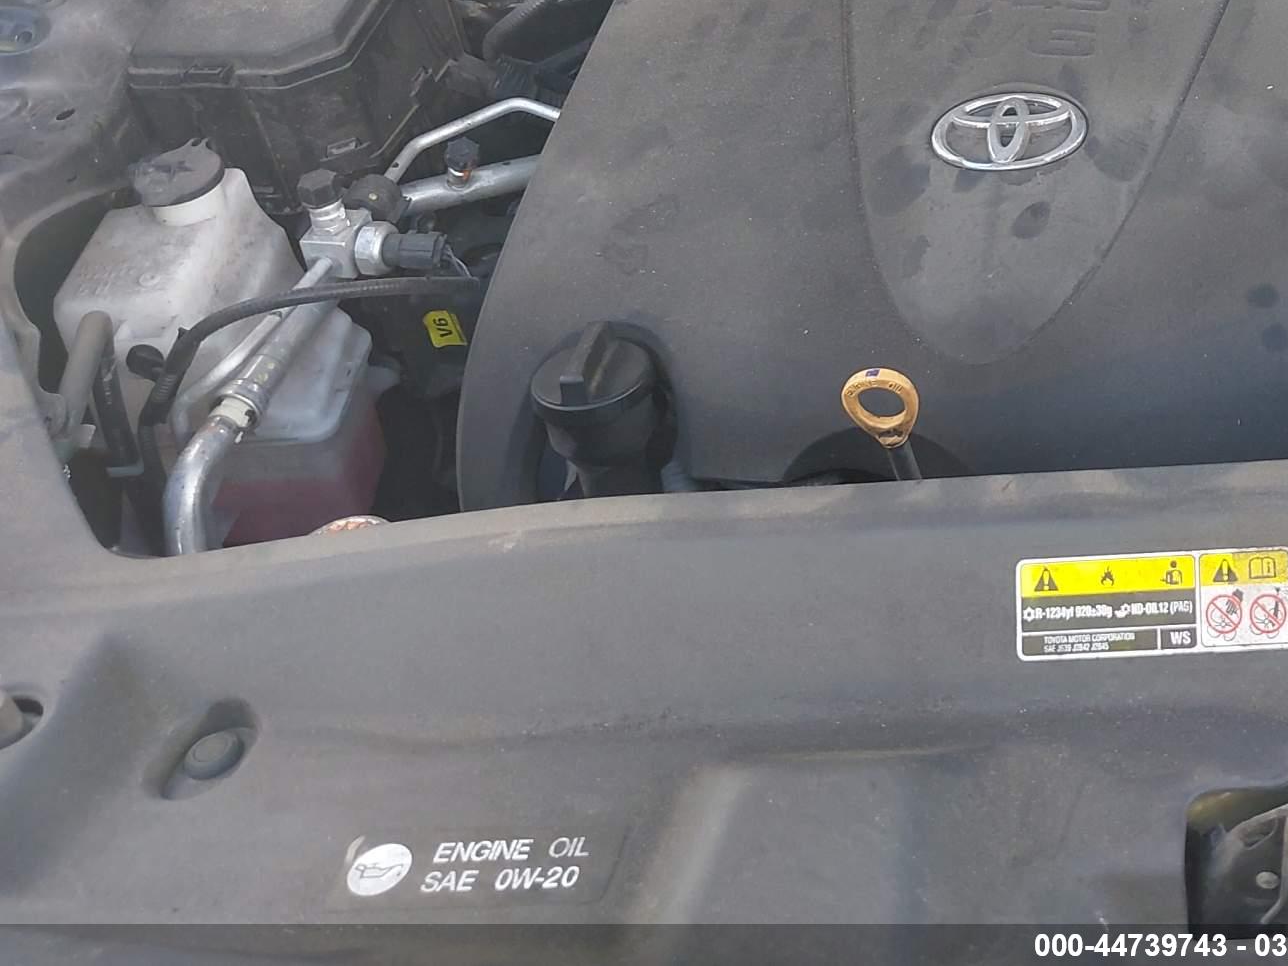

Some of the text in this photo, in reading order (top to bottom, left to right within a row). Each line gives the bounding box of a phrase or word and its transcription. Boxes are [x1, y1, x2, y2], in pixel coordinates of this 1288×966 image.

[432, 318, 453, 338] V6
[1169, 600, 1193, 615] (PAG)
[1044, 632, 1135, 644] TOYOTA MOTOR CORPORATION
[1170, 631, 1192, 645] WS
[432, 836, 590, 863] ENGINE OIL
[420, 866, 580, 893] SAE 0W-20
